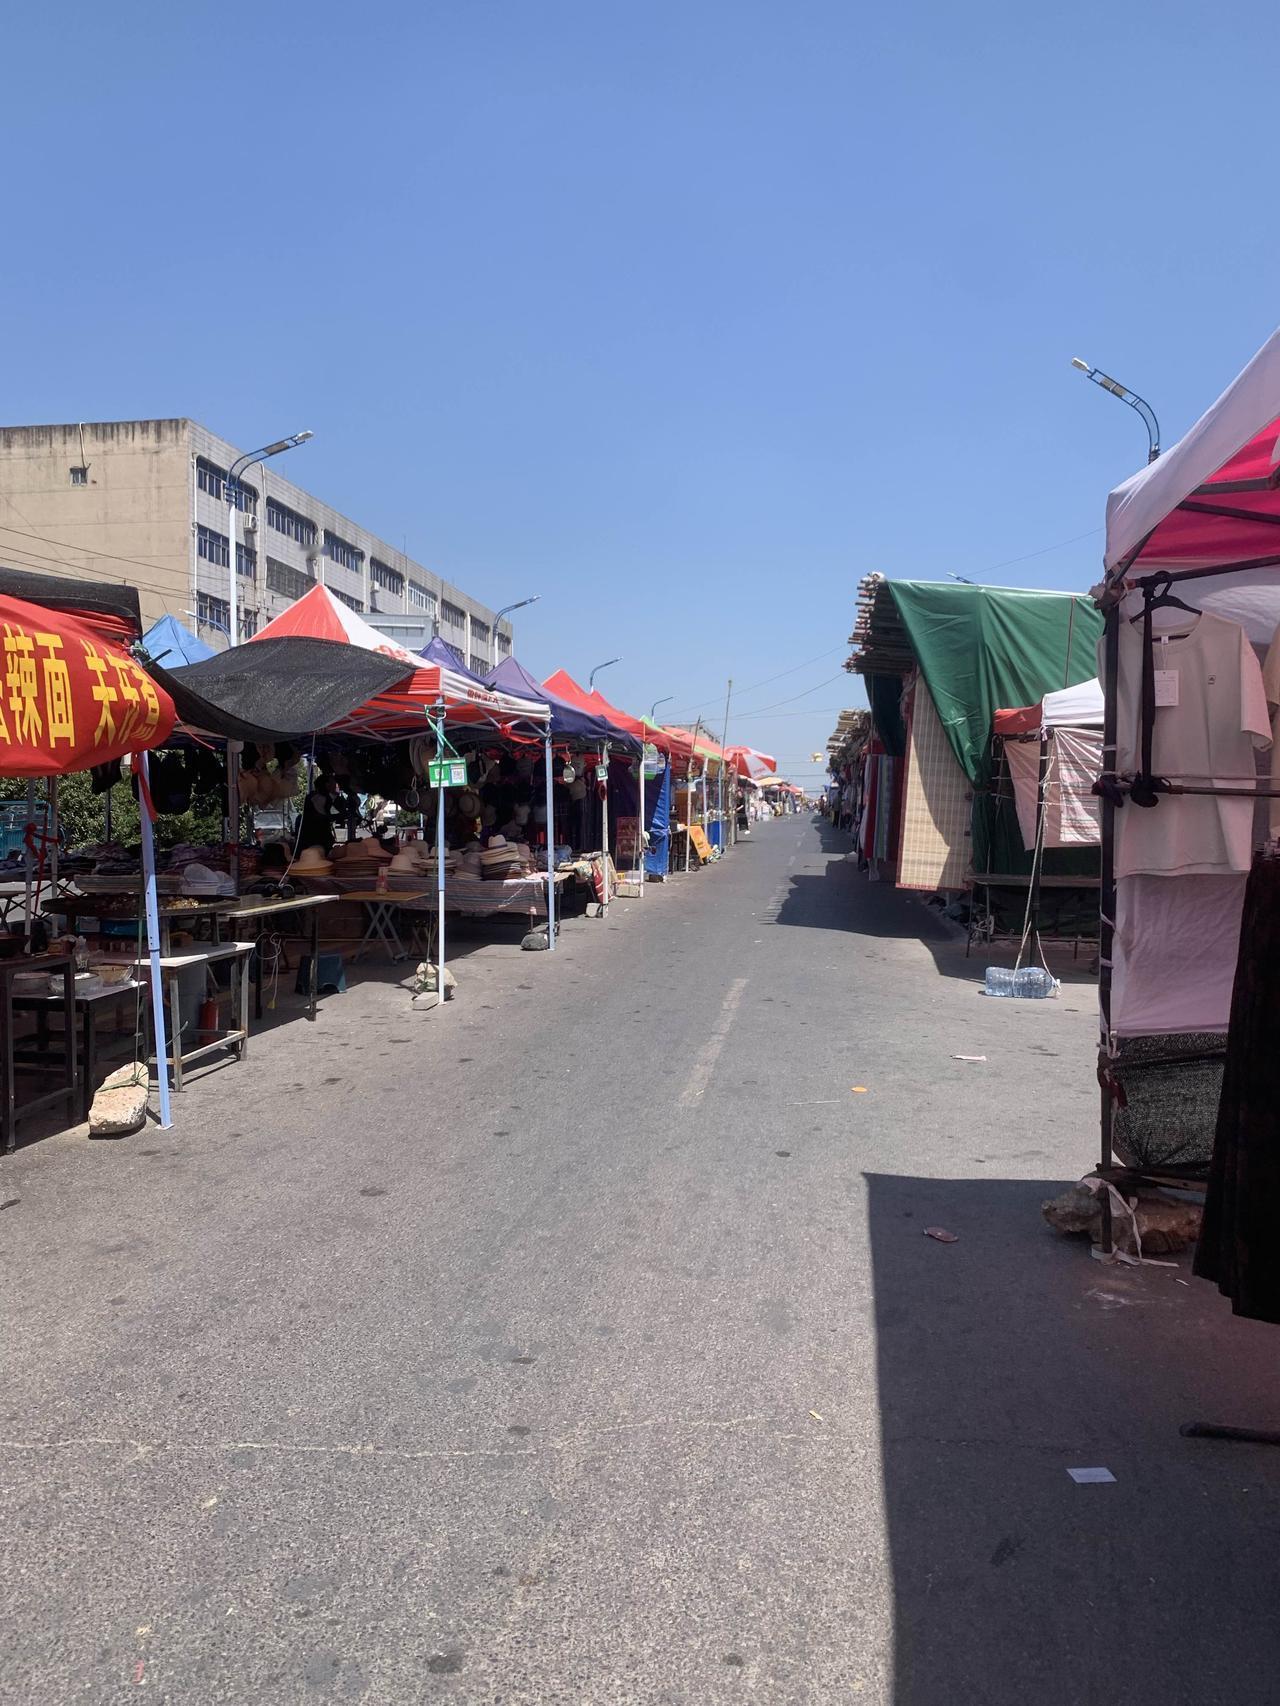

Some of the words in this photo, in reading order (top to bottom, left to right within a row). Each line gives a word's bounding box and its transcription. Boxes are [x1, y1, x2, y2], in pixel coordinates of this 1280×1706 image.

[0, 623, 76, 748] 辣面
[80, 638, 160, 747] 关东煮
